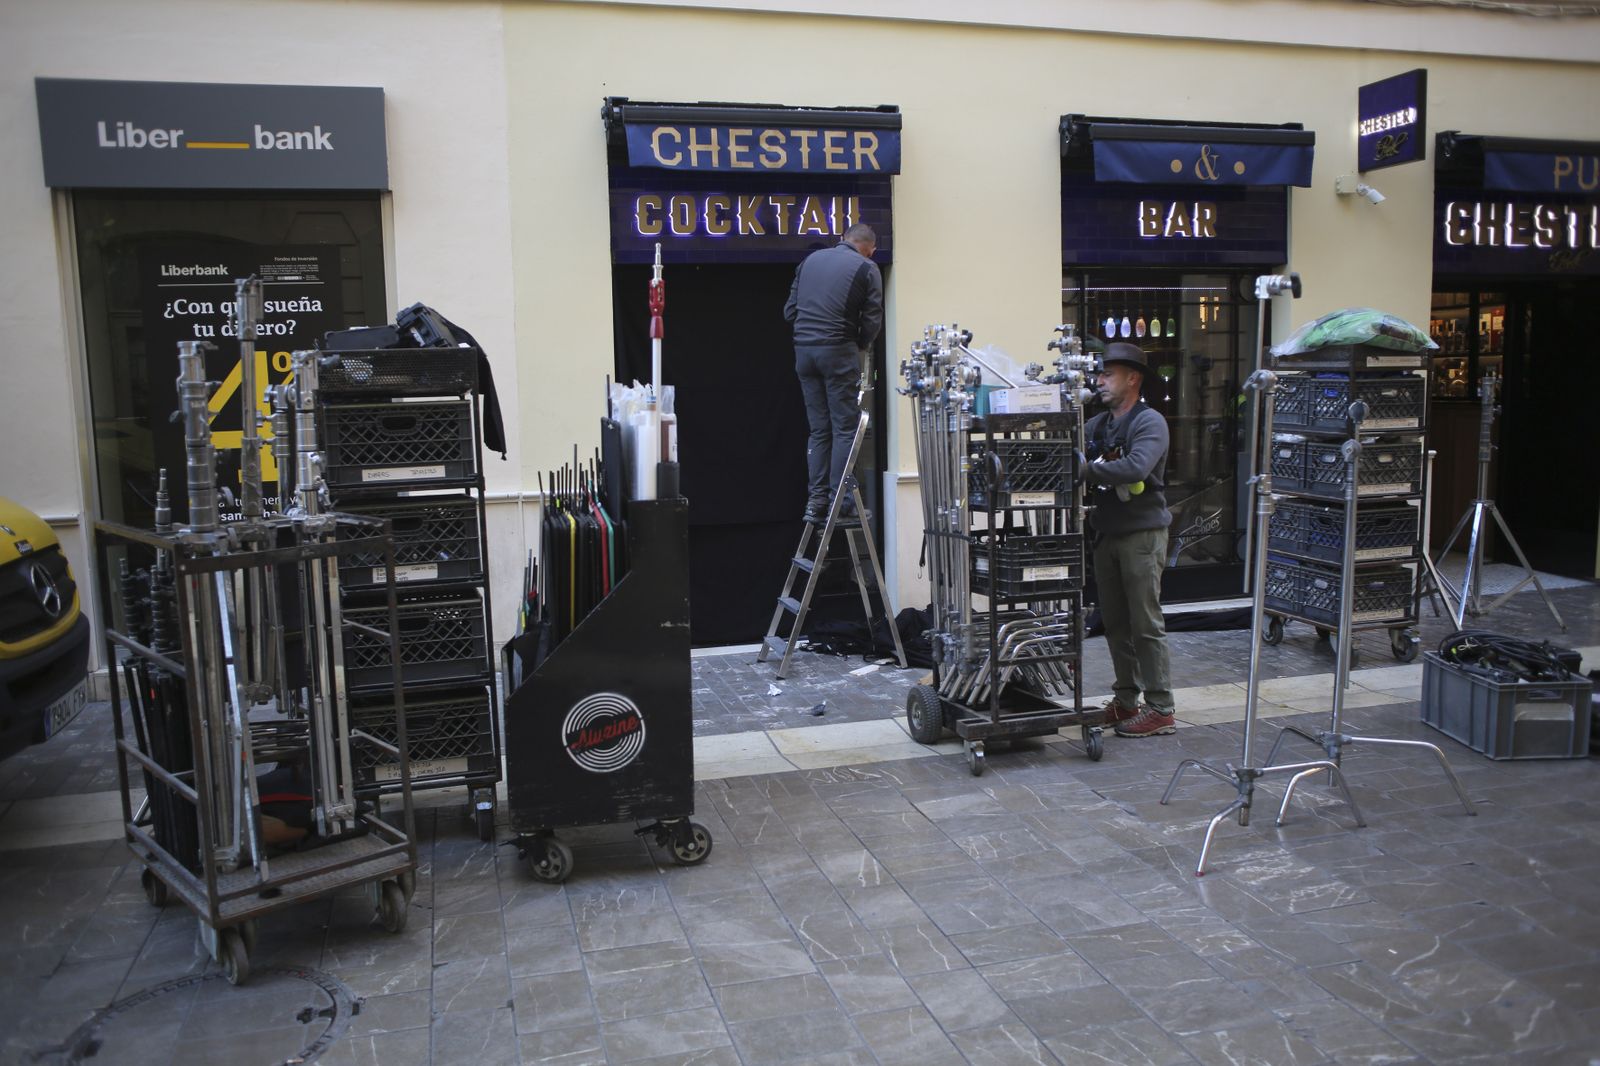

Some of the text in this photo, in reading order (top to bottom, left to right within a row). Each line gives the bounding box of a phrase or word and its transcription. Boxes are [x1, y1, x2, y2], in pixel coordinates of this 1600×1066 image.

[98, 121, 334, 150] Liber bank
[1360, 107, 1417, 136] CHESTER
[651, 126, 880, 170] CHESTER
[1195, 144, 1220, 181] &
[1139, 201, 1217, 238] BAR
[161, 264, 229, 277] Liberbank
[163, 298, 215, 319] ¿Con
[264, 296, 323, 313] sueña
[193, 319, 297, 337] tu diero?
